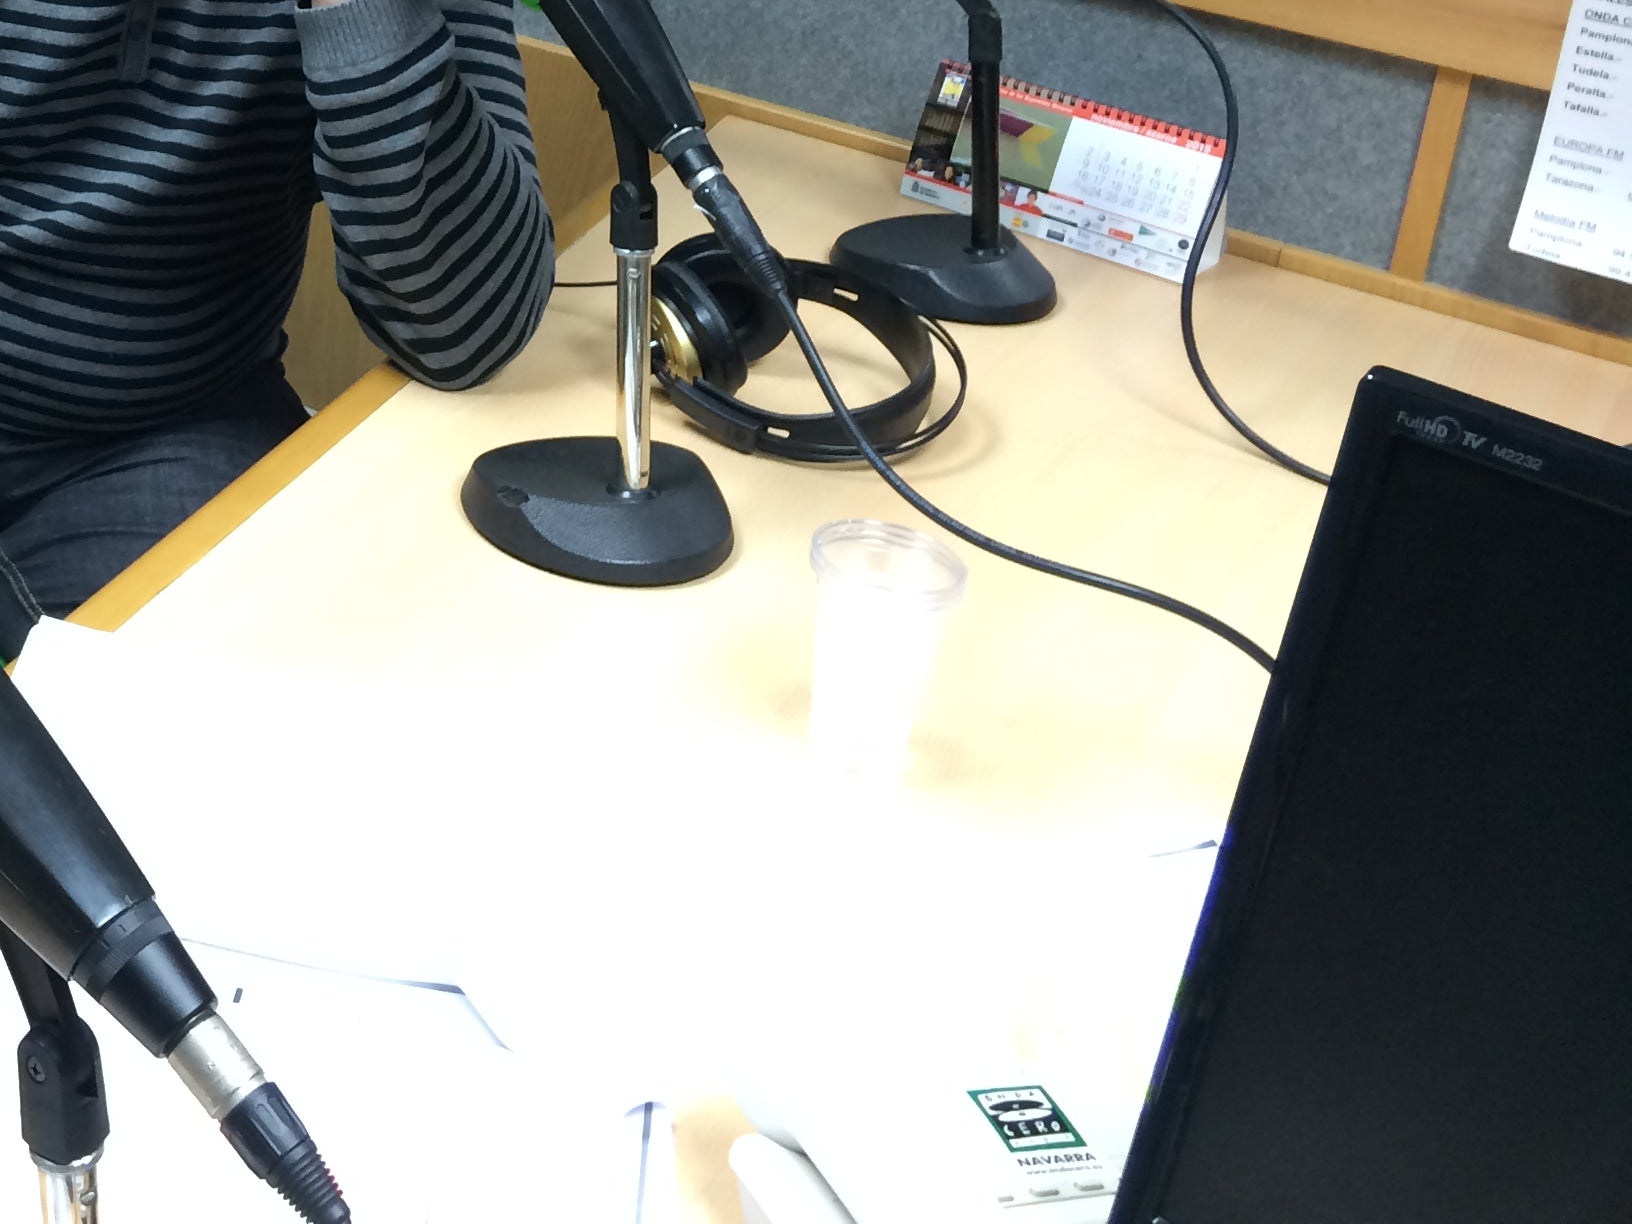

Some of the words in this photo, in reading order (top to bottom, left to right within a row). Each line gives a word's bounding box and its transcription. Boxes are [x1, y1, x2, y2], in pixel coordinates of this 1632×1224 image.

[1584, 8, 1619, 23] ONDA
[1553, 136, 1604, 155] EUROPA
[1607, 147, 1625, 162] FM
[1462, 431, 1487, 449] TV
[1003, 1120, 1061, 1137] CERO
[1017, 1152, 1097, 1167] NAVARRA
